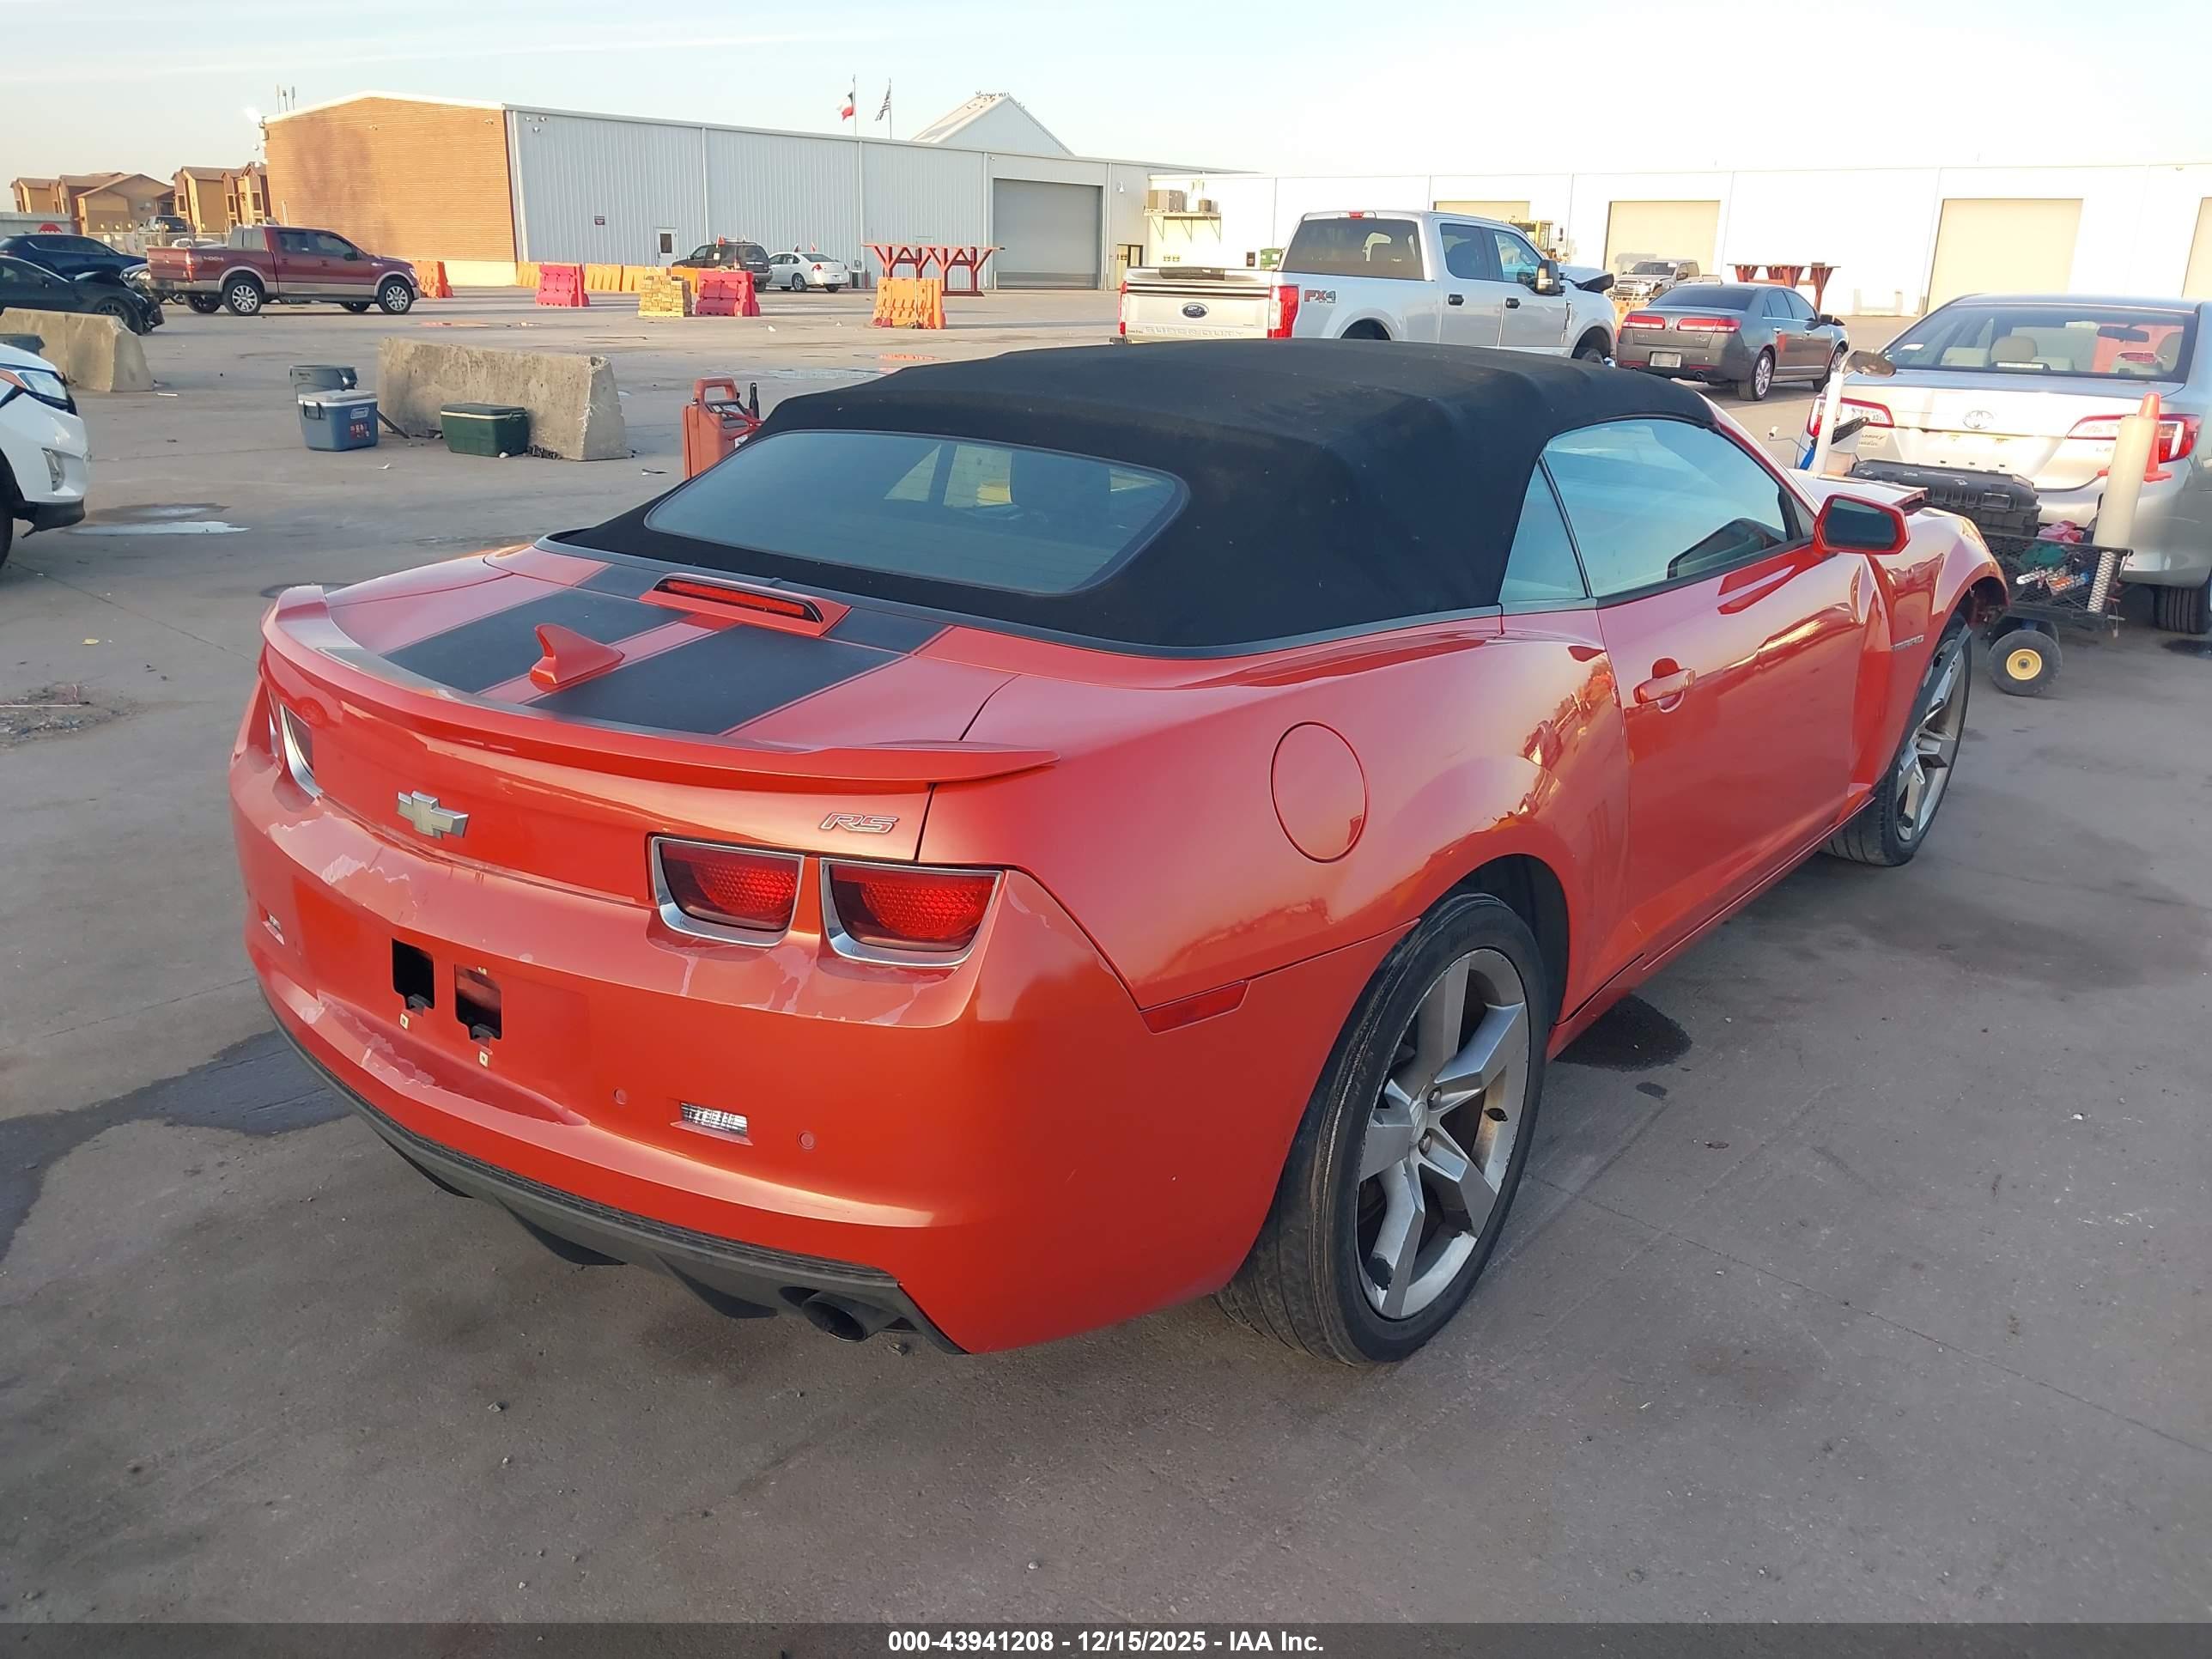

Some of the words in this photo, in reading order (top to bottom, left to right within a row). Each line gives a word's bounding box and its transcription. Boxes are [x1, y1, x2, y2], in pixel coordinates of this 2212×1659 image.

[1304, 289, 1337, 301] FX4
[1146, 325, 1197, 336] SUPER
[818, 812, 899, 833] RS
